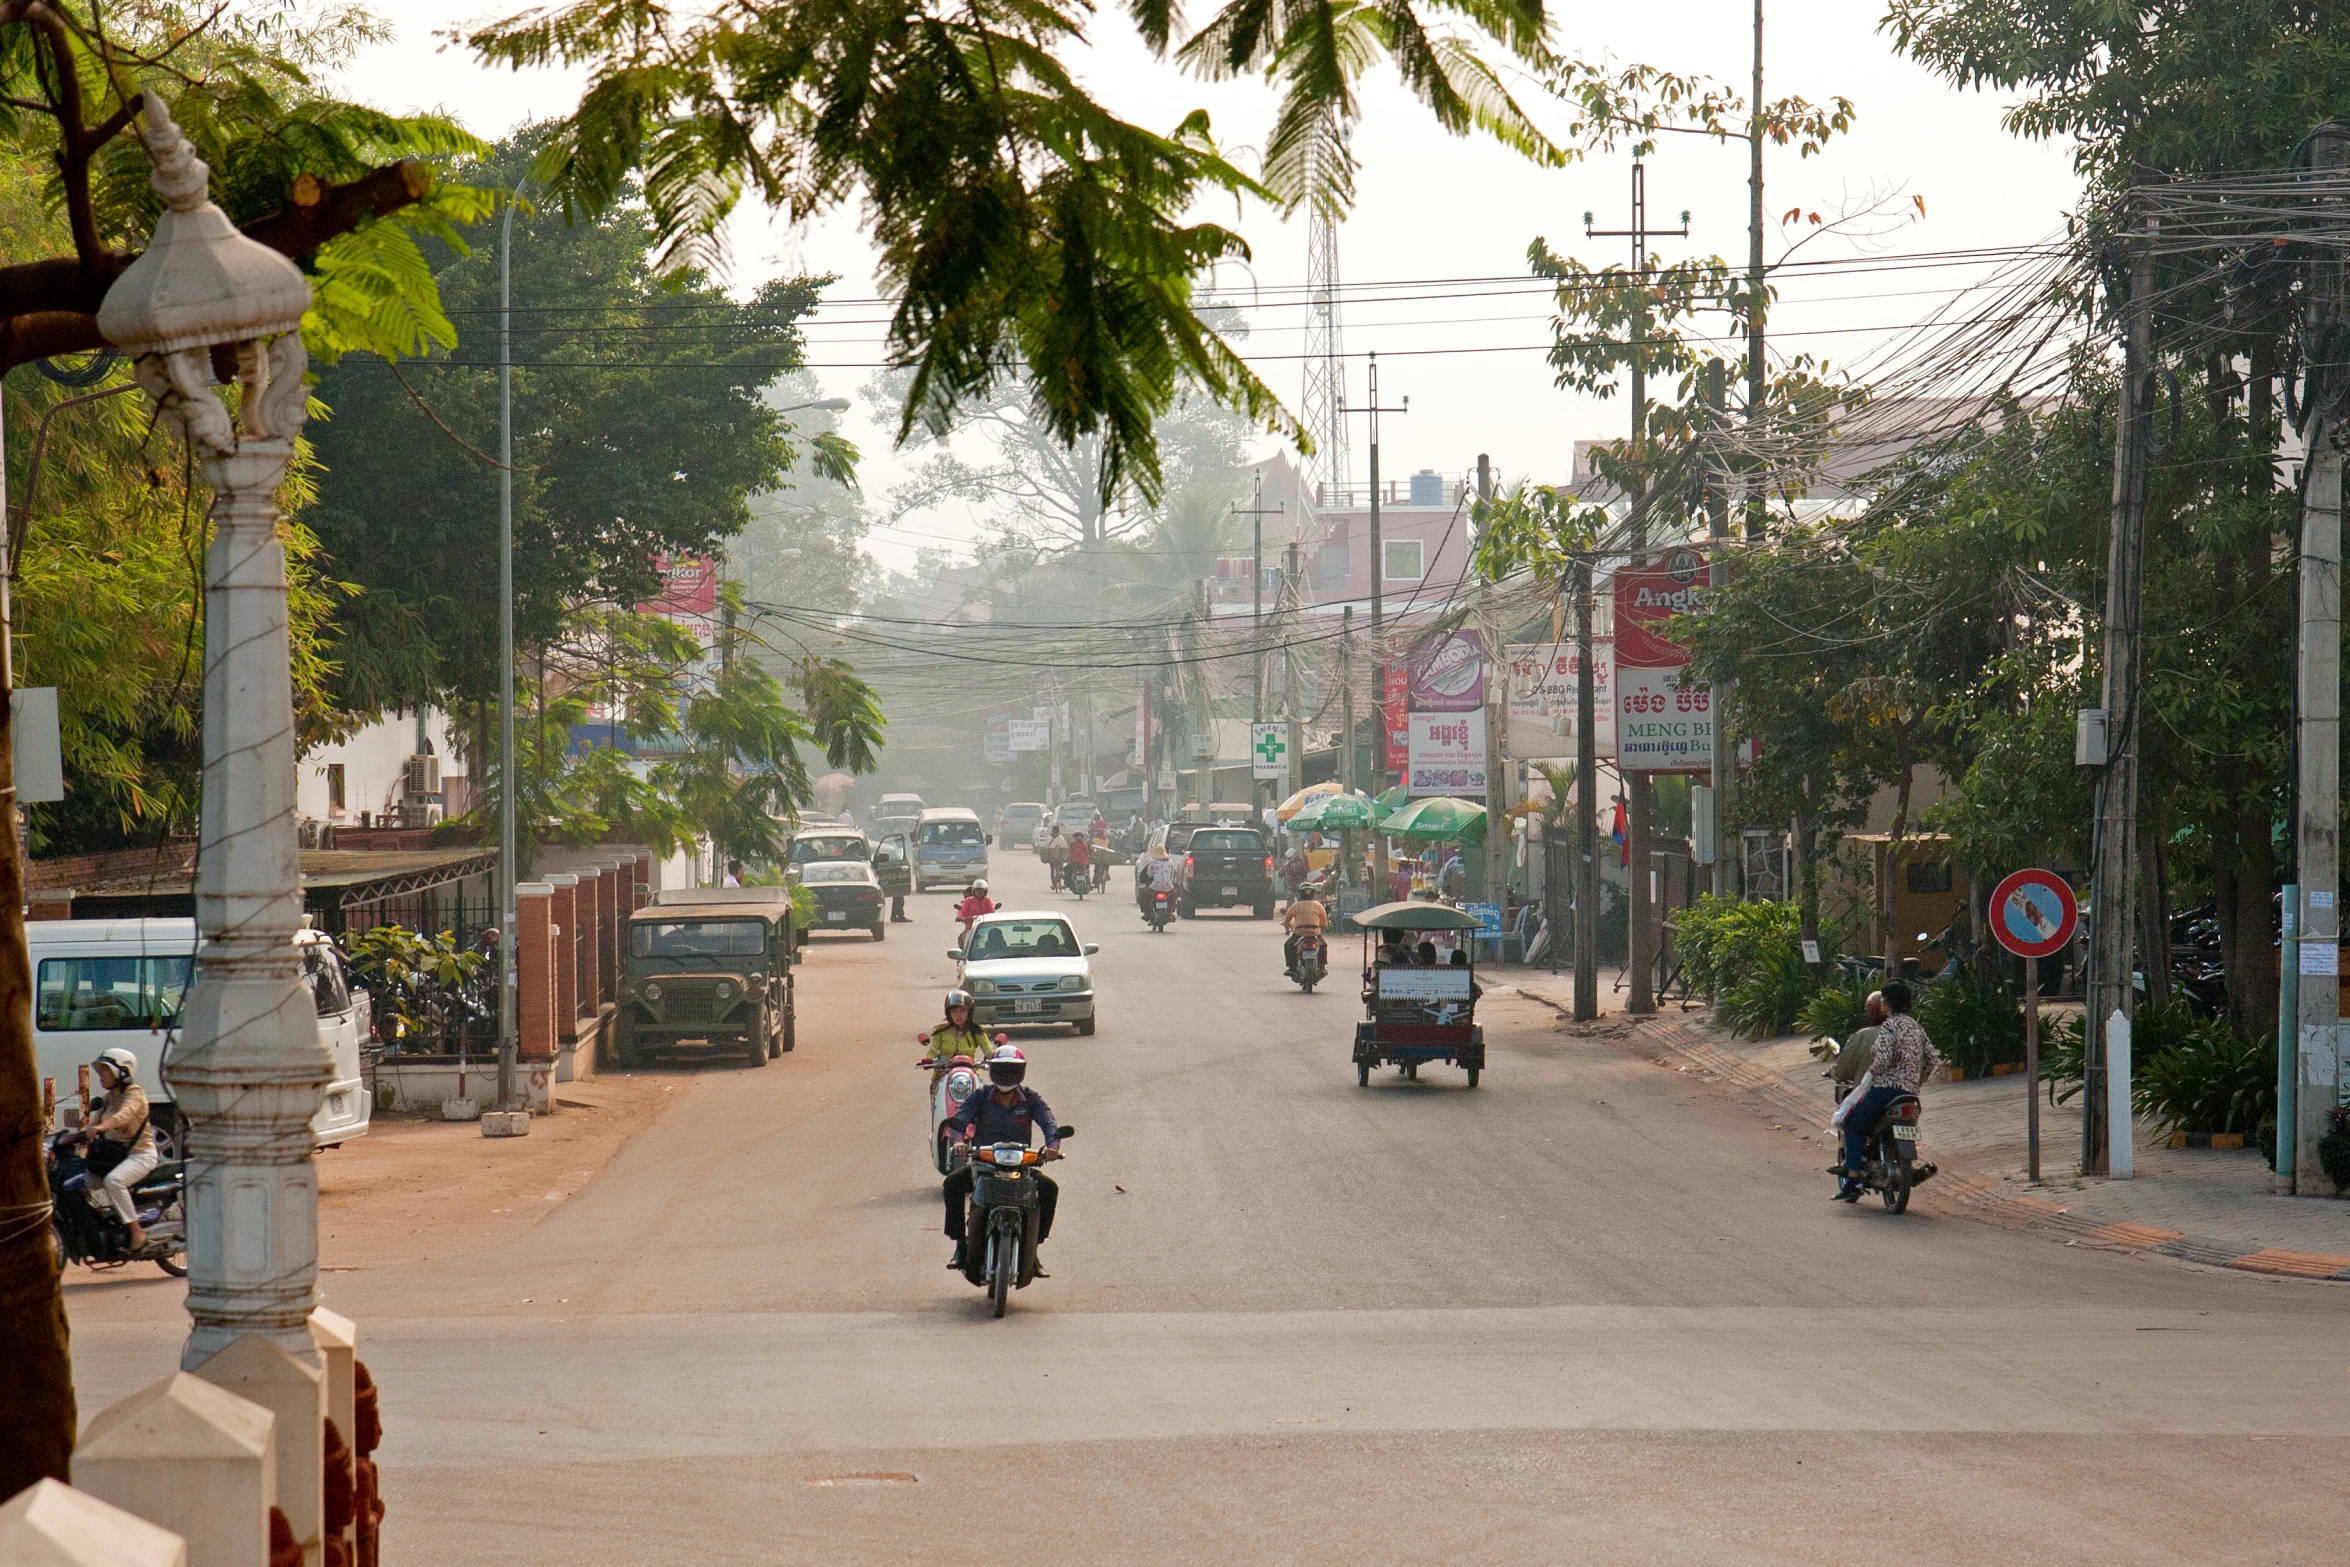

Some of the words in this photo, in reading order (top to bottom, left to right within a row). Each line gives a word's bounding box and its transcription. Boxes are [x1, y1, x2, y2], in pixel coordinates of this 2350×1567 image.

[1634, 586, 1704, 615] Angk
[1389, 677, 1408, 685] HOU
[1628, 723, 1687, 737] MENG
[1689, 740, 1711, 752] Bu
[1415, 821, 1446, 830] Smart
